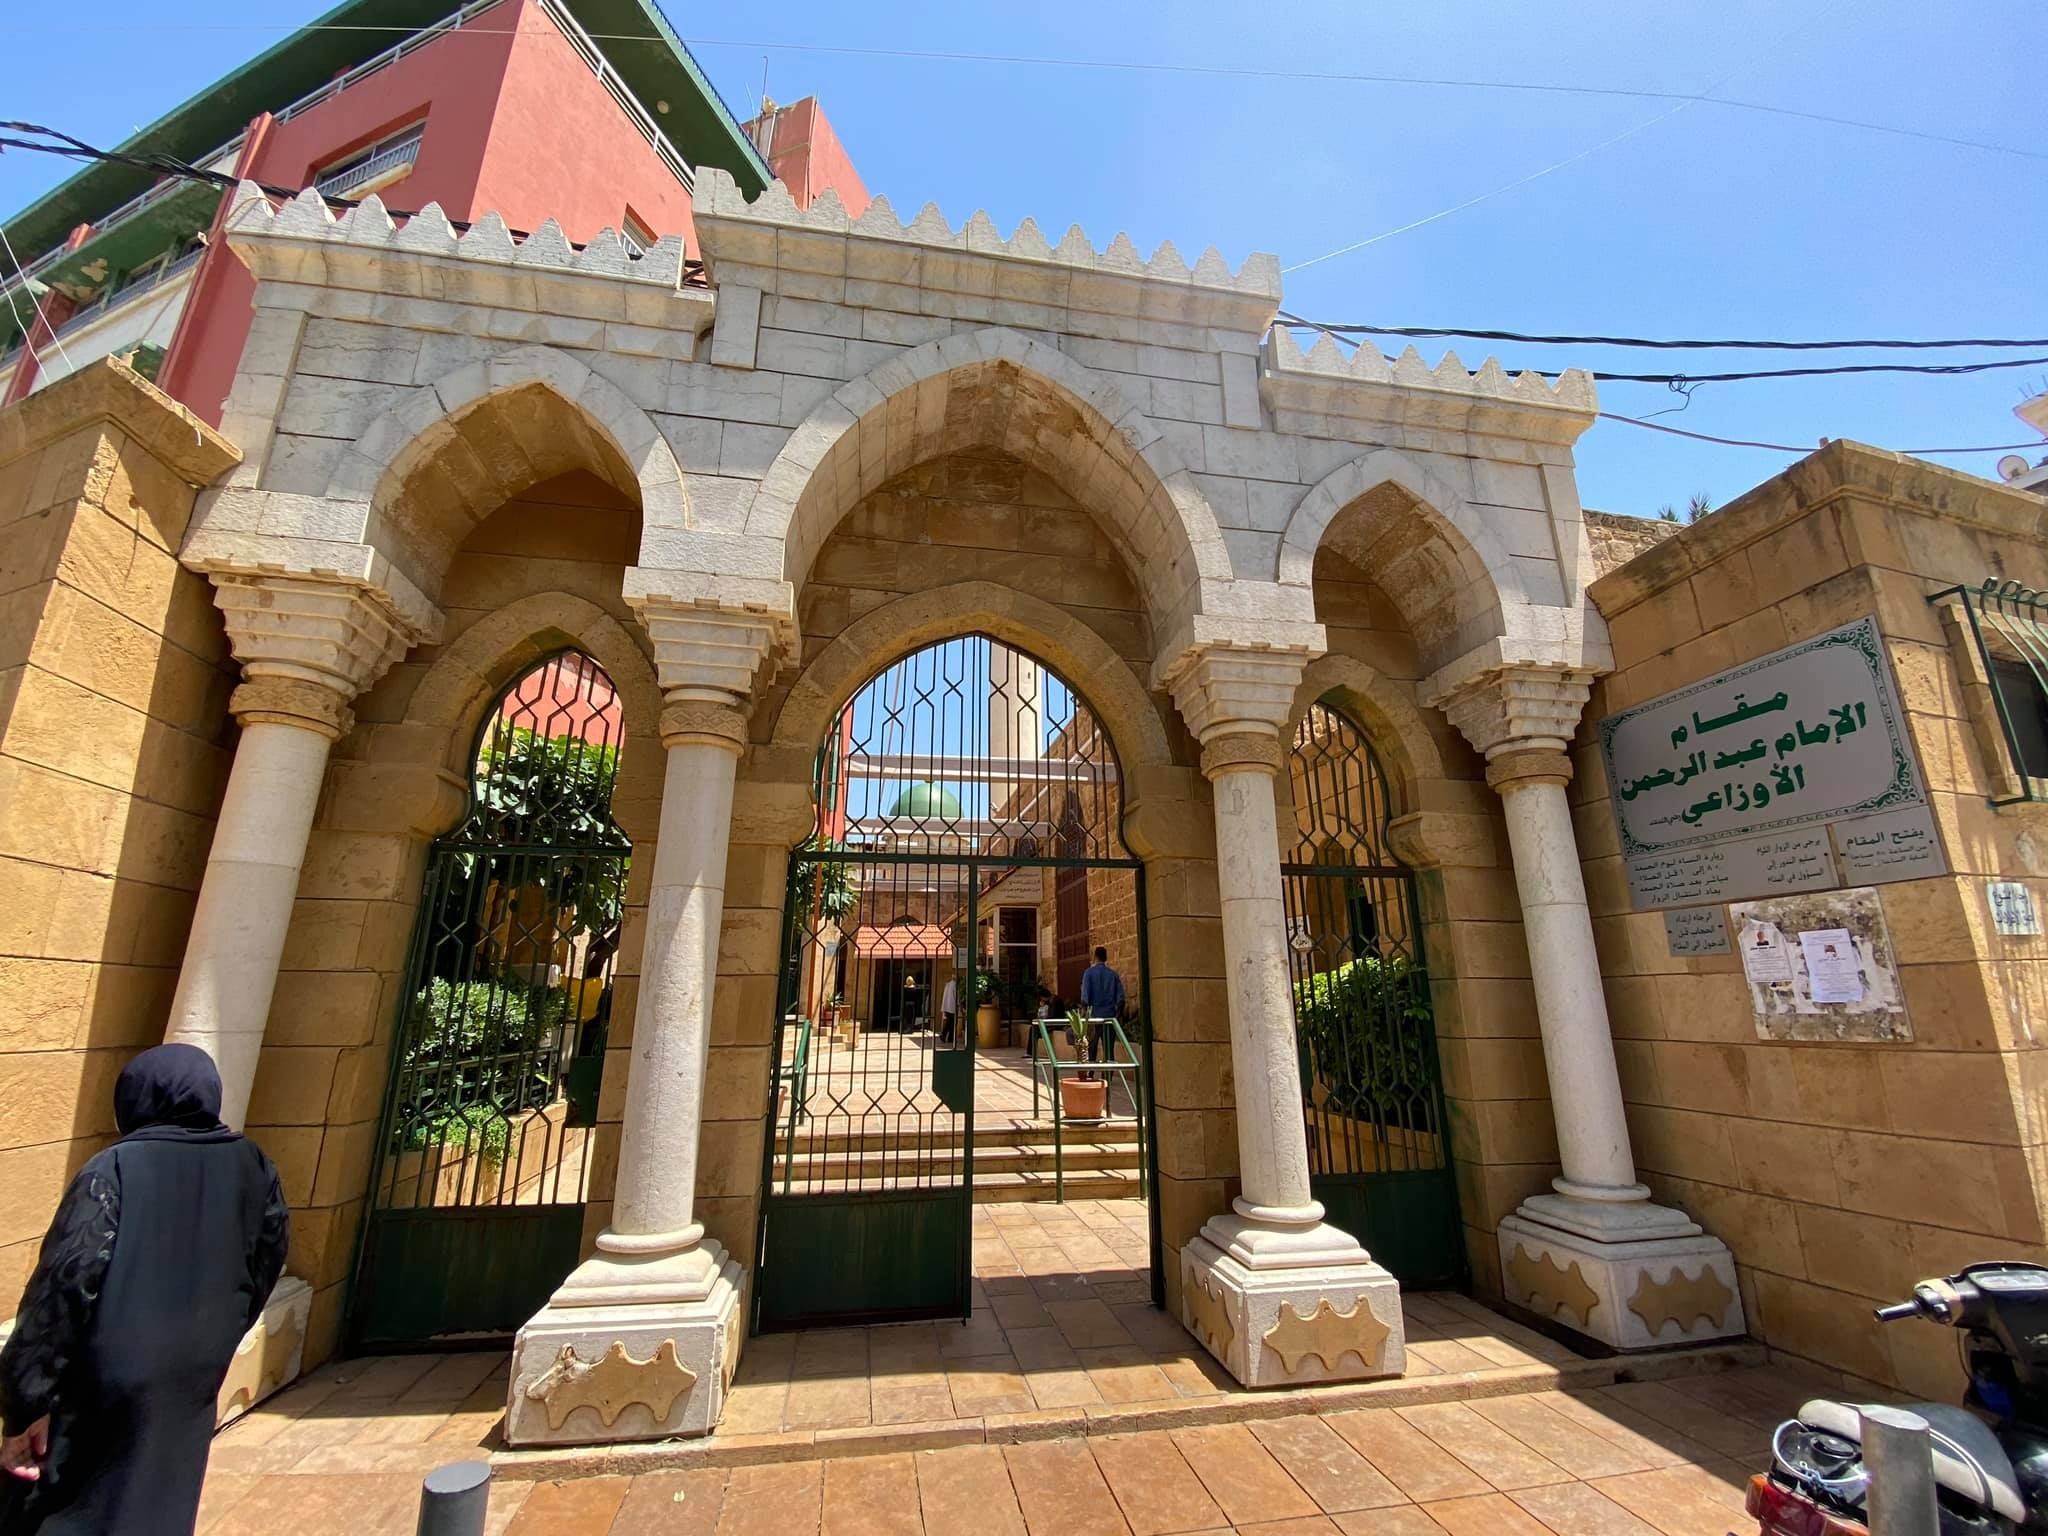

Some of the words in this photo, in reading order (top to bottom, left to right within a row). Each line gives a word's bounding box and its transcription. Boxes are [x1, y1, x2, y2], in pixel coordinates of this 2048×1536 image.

[1671, 692, 1788, 749] مقام
[1775, 702, 1867, 760] الإمام
[1621, 751, 1707, 801] الرحمن
[1713, 739, 1767, 769] عبد
[1681, 763, 1805, 826] الأوزاعي
[1847, 832, 1885, 850] المقام
[1891, 828, 1924, 844] يفتح
